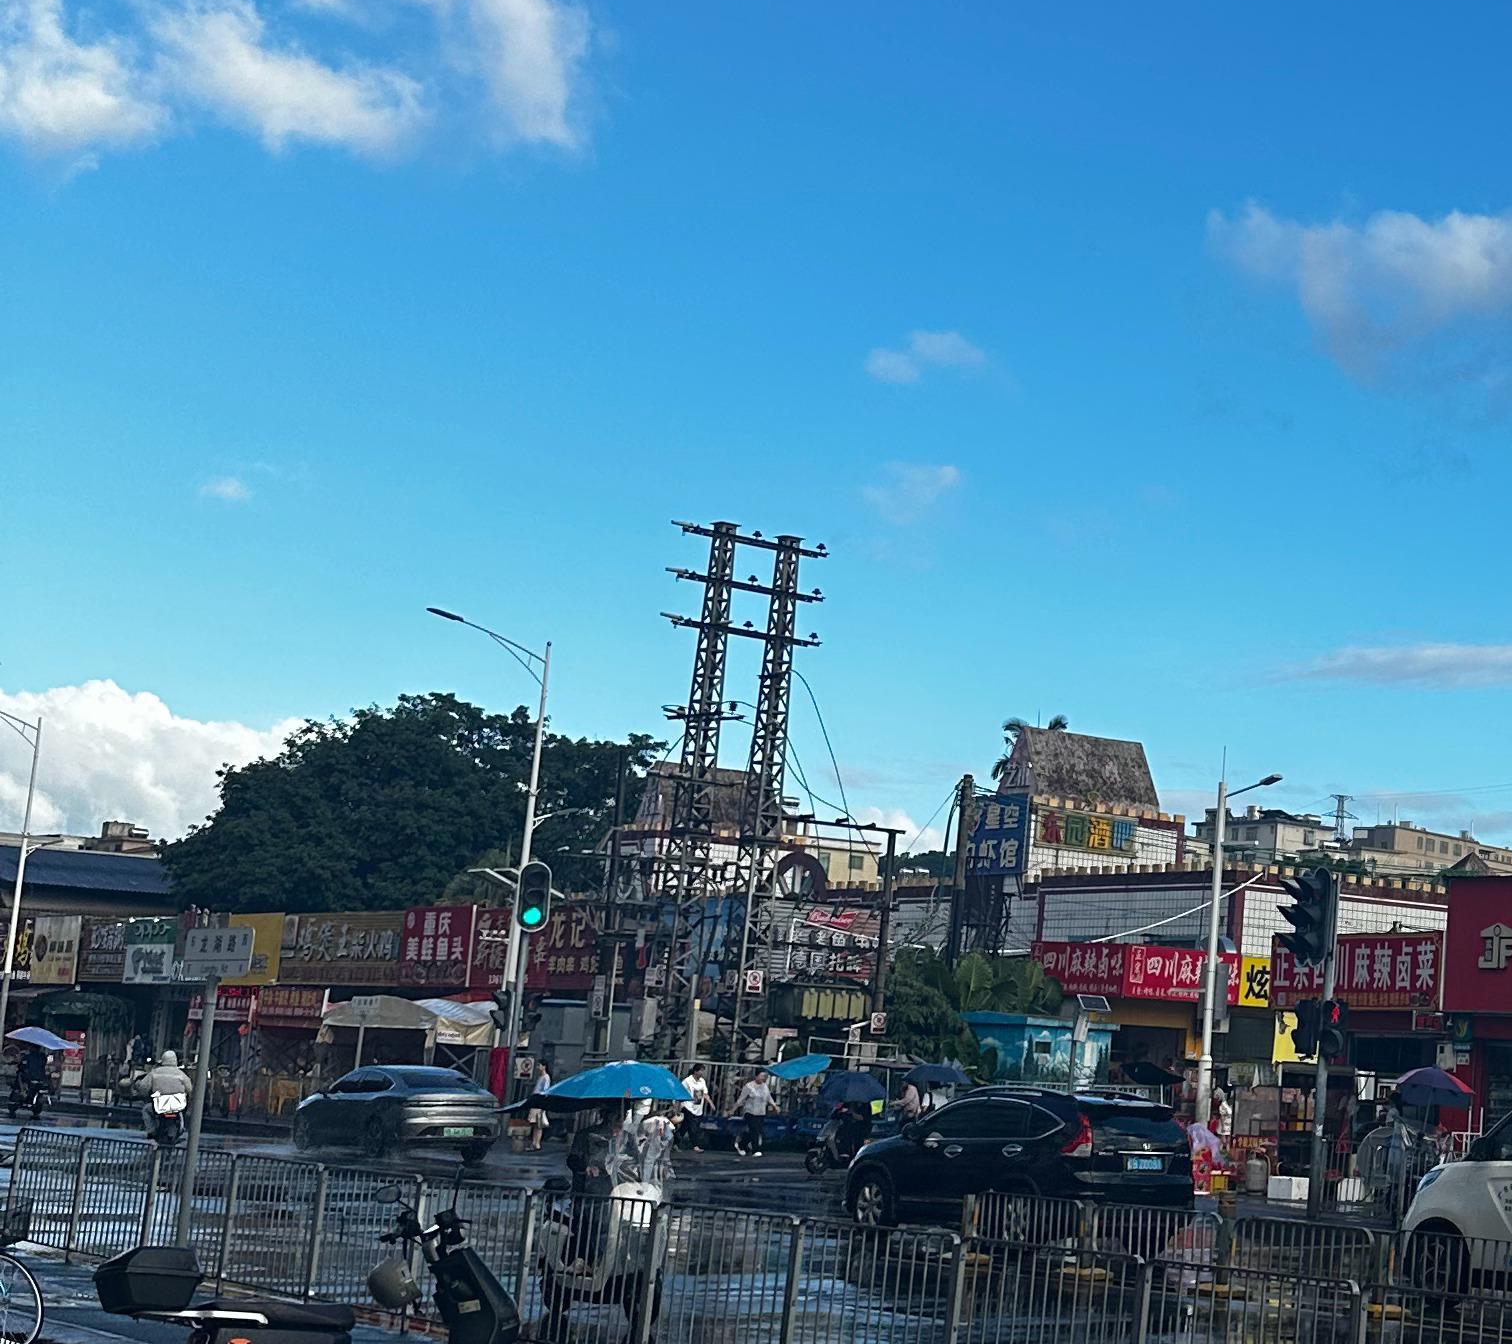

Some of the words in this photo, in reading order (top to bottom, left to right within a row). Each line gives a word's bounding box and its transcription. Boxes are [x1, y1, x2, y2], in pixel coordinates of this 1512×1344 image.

[424, 911, 452, 936] 重庆
[406, 936, 464, 961] 美蛙鱼头
[1043, 946, 1123, 979] 四川麻辣卤味
